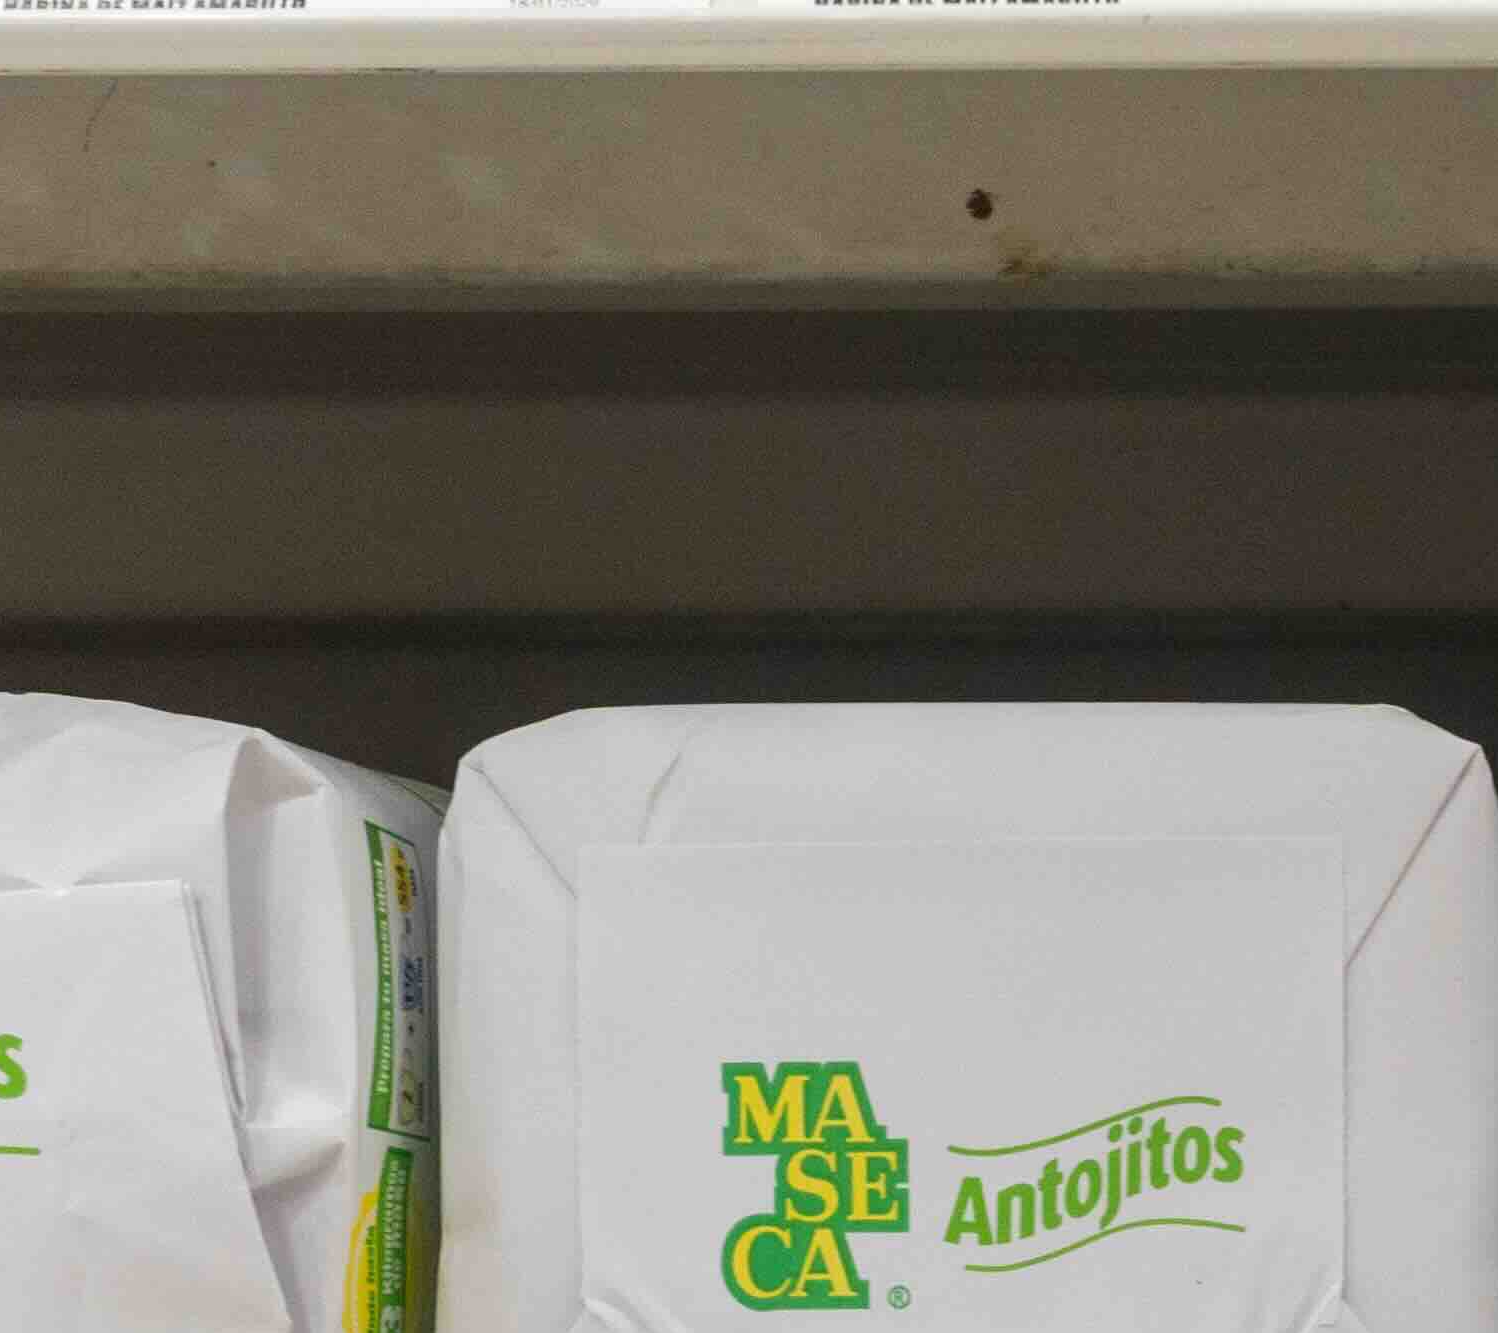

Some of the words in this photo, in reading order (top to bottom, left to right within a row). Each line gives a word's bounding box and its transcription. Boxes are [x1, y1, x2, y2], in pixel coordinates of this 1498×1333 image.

[733, 1074, 874, 1144] MA
[786, 1150, 899, 1223] SE
[944, 1117, 1247, 1245] Antojitos
[732, 1227, 857, 1298] CA
